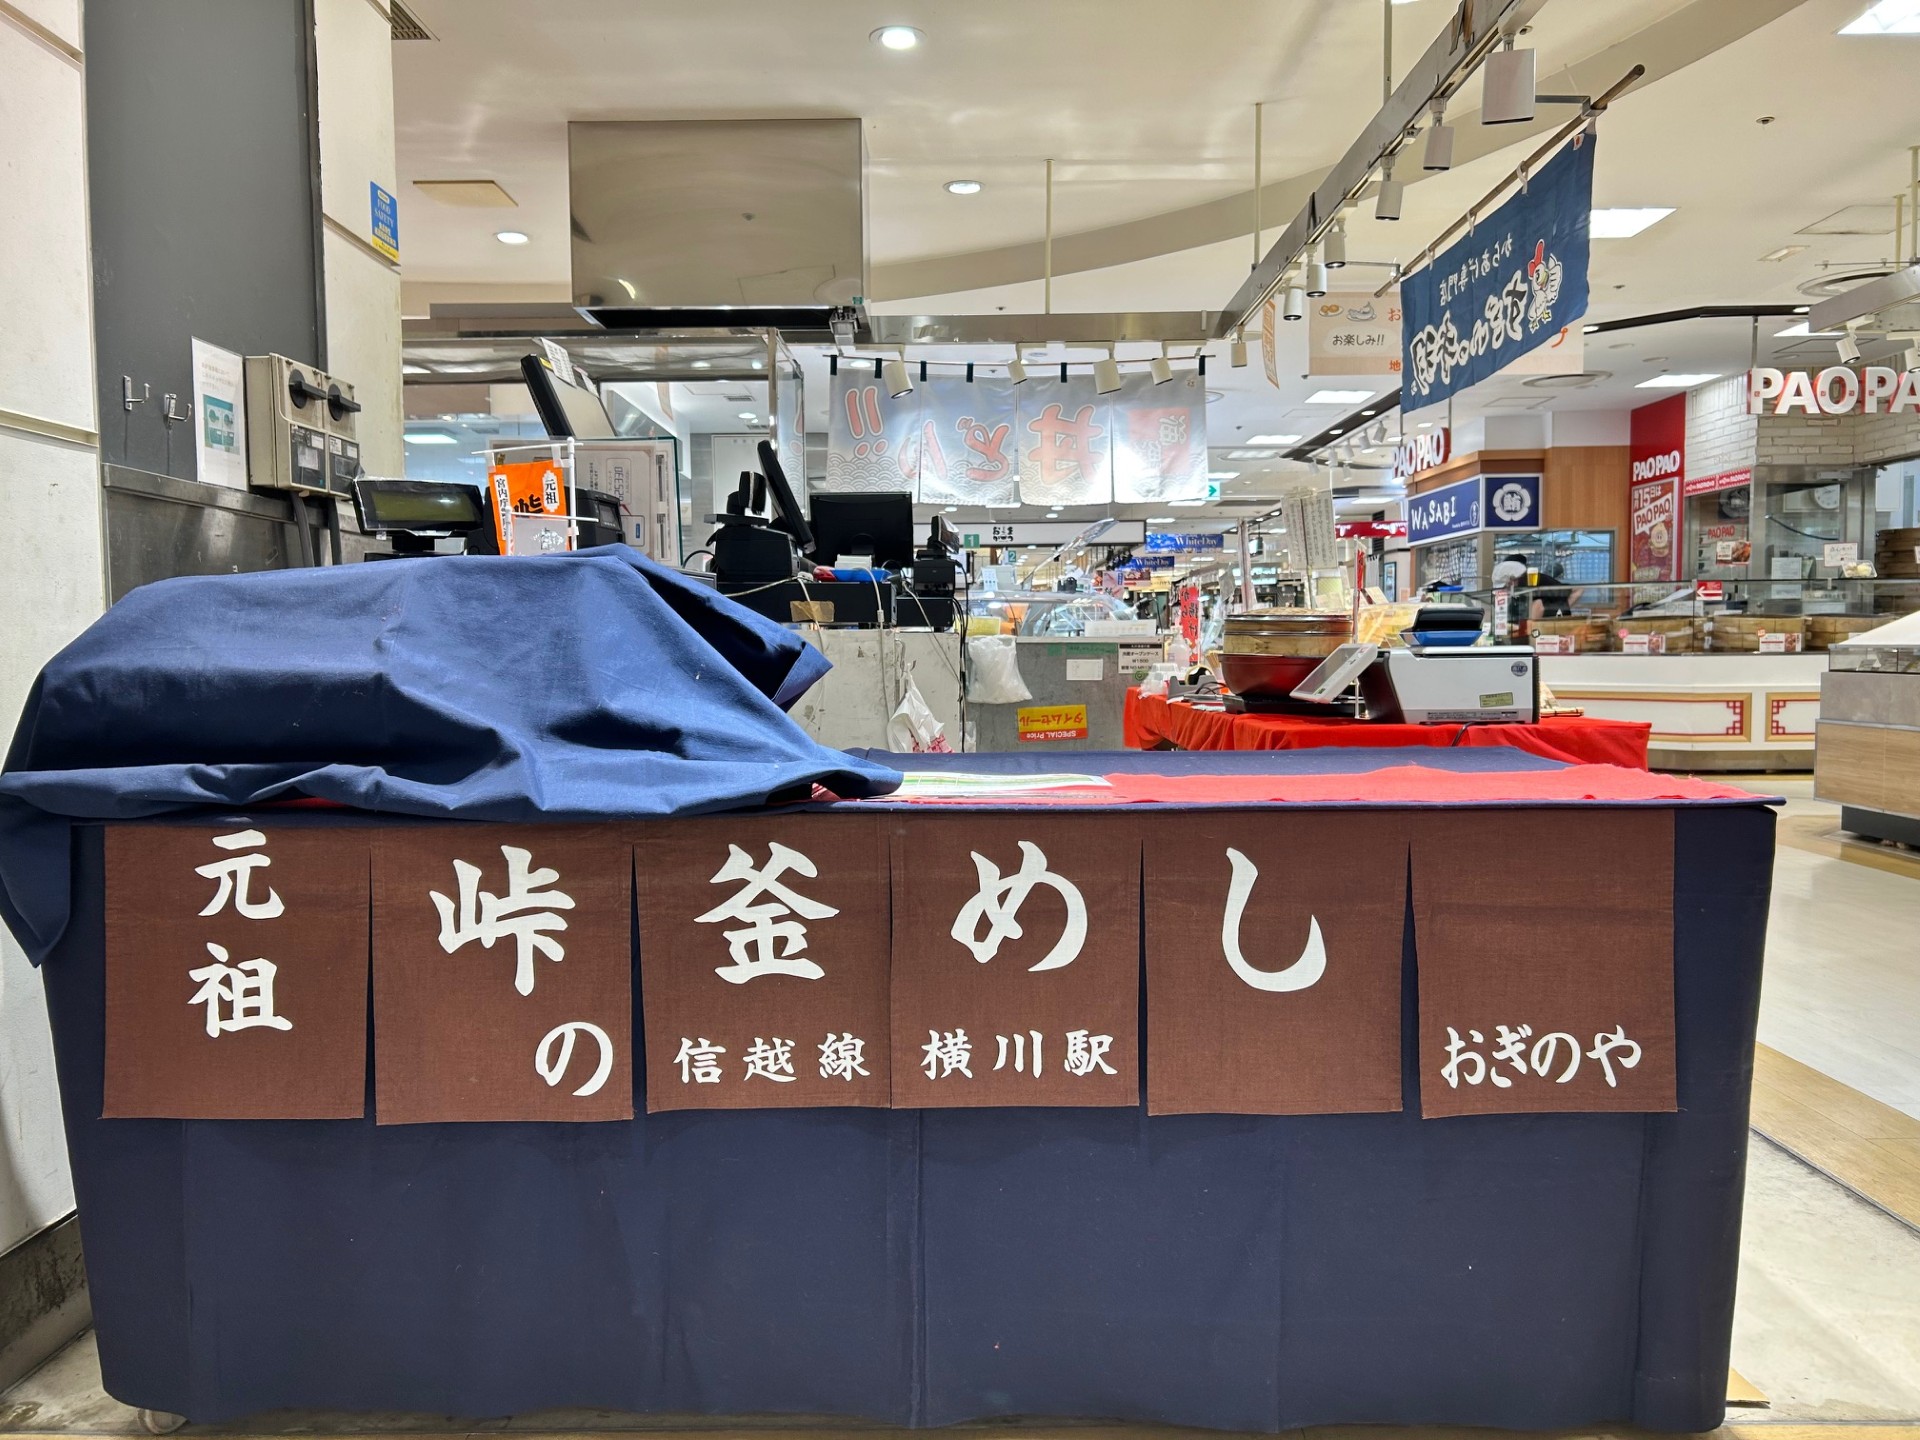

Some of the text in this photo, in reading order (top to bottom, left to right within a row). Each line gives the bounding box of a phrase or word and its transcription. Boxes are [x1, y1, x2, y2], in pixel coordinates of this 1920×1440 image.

[1392, 427, 1446, 479] PAOPAO
[1632, 450, 1680, 482] PAOPAO
[545, 478, 557, 505] 元祖
[1411, 496, 1457, 531] WASABI
[1636, 498, 1671, 530] PAOPAO
[1019, 712, 1083, 727] タイムセール
[1026, 730, 1076, 739] SPECIAL Price
[187, 829, 293, 1038] 元祖
[672, 1029, 1118, 1084] 信越線 横川駅
[1440, 1024, 1642, 1089] おぎのや
